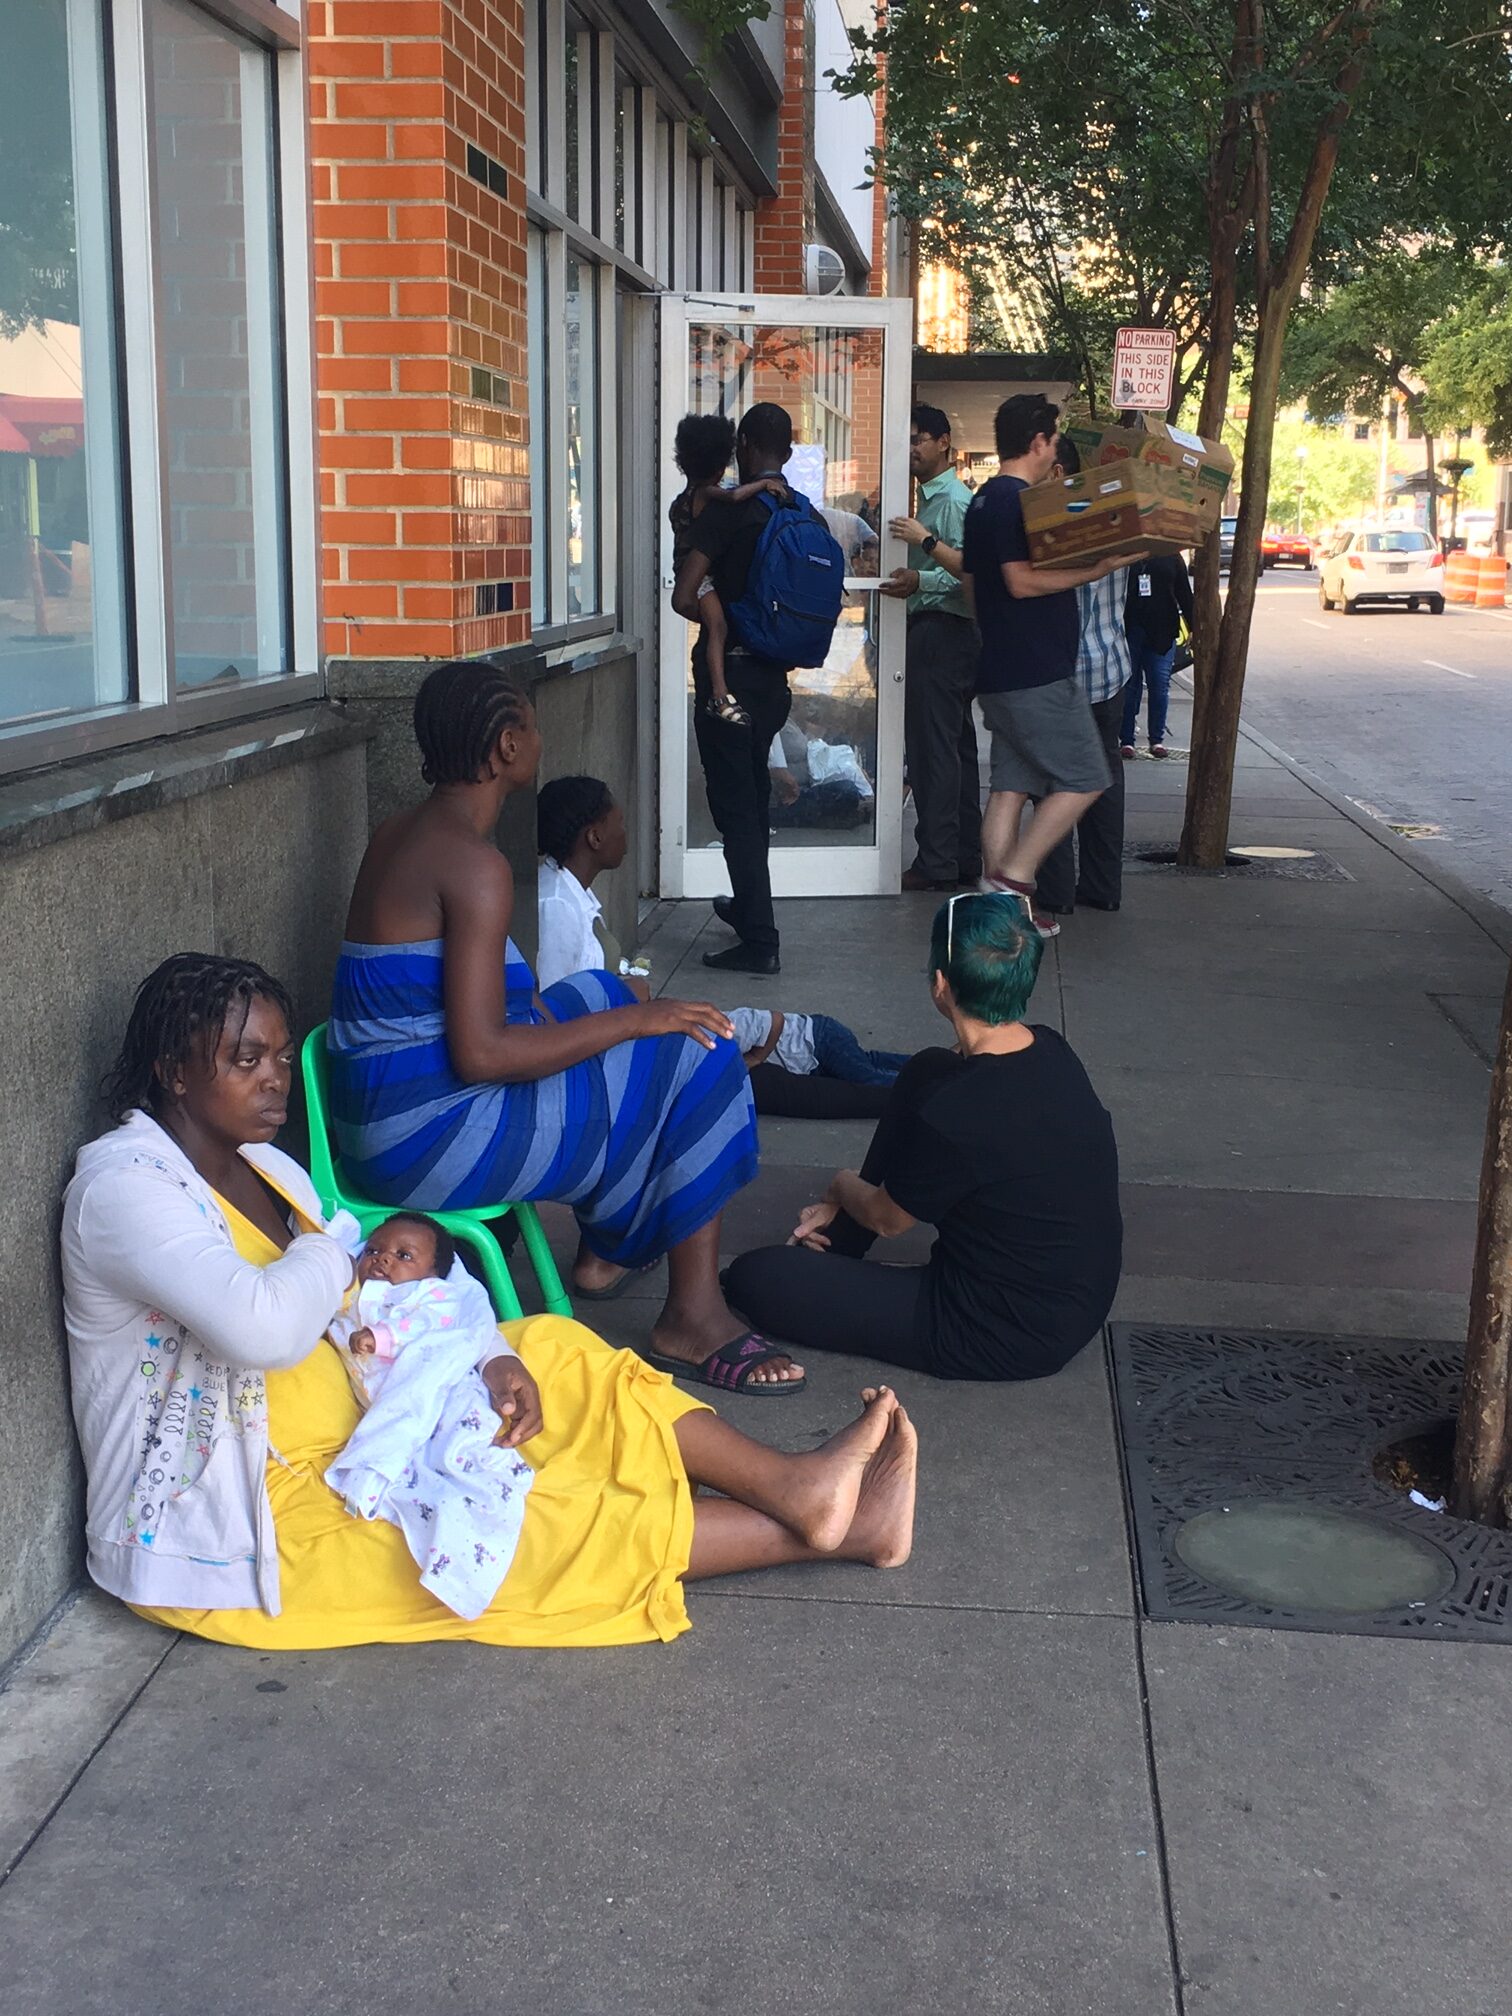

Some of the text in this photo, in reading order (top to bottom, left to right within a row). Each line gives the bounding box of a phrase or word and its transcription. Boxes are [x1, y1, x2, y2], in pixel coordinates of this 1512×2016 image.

[1118, 331, 1171, 347] NO PARKING
[1120, 353, 1169, 366] THIS SIDE
[1121, 368, 1164, 380] IN THIS
[1122, 381, 1161, 394] BLOCK
